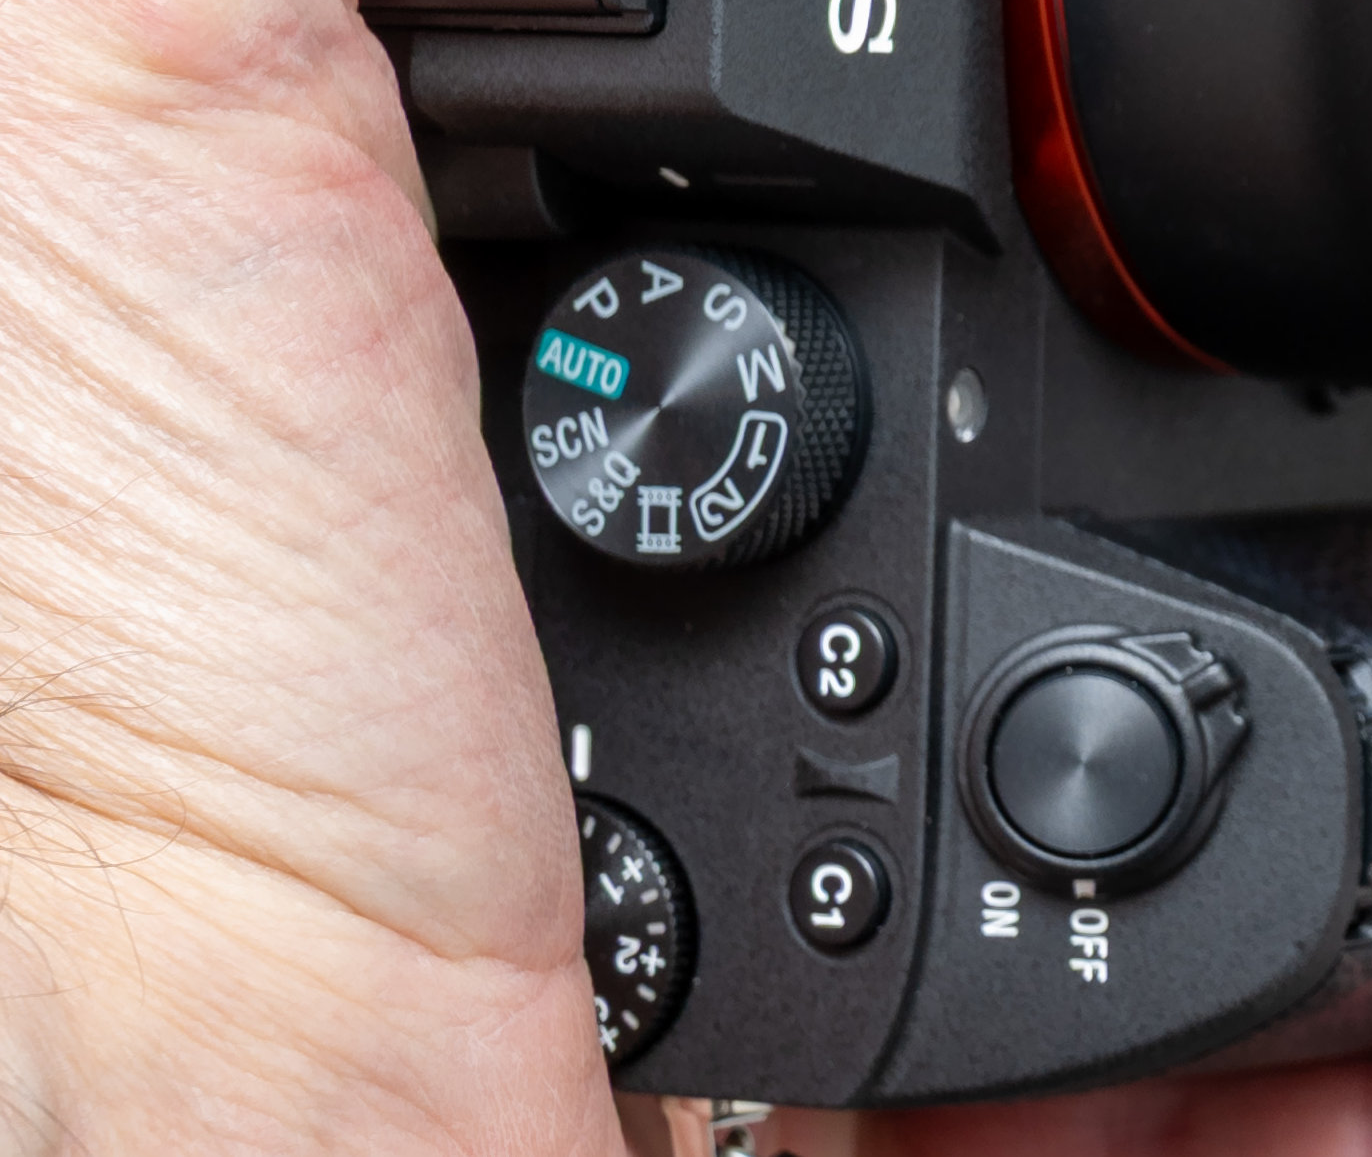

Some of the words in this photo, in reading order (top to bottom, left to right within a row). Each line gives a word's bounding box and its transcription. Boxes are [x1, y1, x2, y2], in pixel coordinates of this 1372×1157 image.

[573, 276, 620, 319] P
[641, 260, 684, 304] A
[703, 283, 747, 331] S
[539, 336, 623, 395] AUTO
[737, 343, 786, 403] M
[531, 406, 610, 468] SCN
[747, 422, 768, 469] 1
[572, 450, 642, 537] S&Q
[701, 477, 745, 526] 2
[820, 623, 861, 697] C2
[811, 863, 852, 928] C1
[980, 880, 1021, 937] ON
[1069, 908, 1110, 983] OFF
